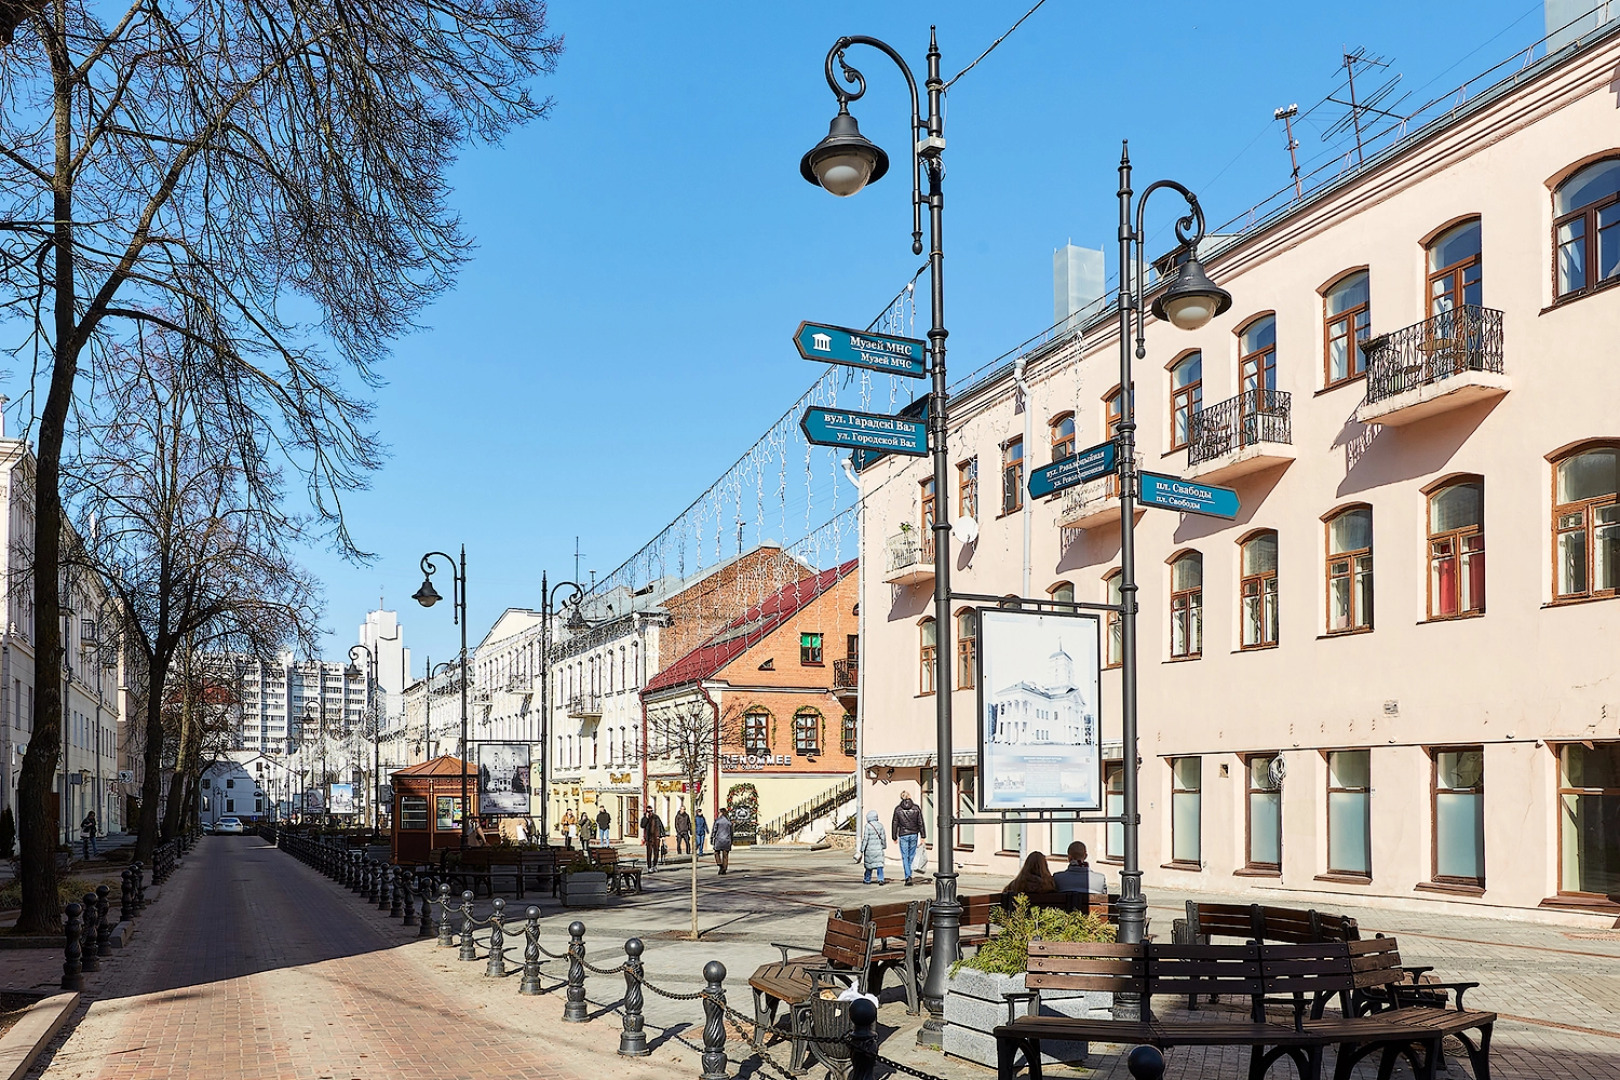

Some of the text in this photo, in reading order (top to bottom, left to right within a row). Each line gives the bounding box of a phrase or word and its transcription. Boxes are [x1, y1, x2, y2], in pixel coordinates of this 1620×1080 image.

[850, 335, 912, 355] Музей МНС
[861, 352, 912, 369] Музей МЧС
[824, 414, 916, 432] вул. Гарадскі Вал
[837, 432, 916, 448] ул. Городской Вал
[1156, 482, 1212, 499] пл. Свабоды
[1168, 497, 1201, 510] Свободы
[722, 754, 792, 766] RENOMMEE
